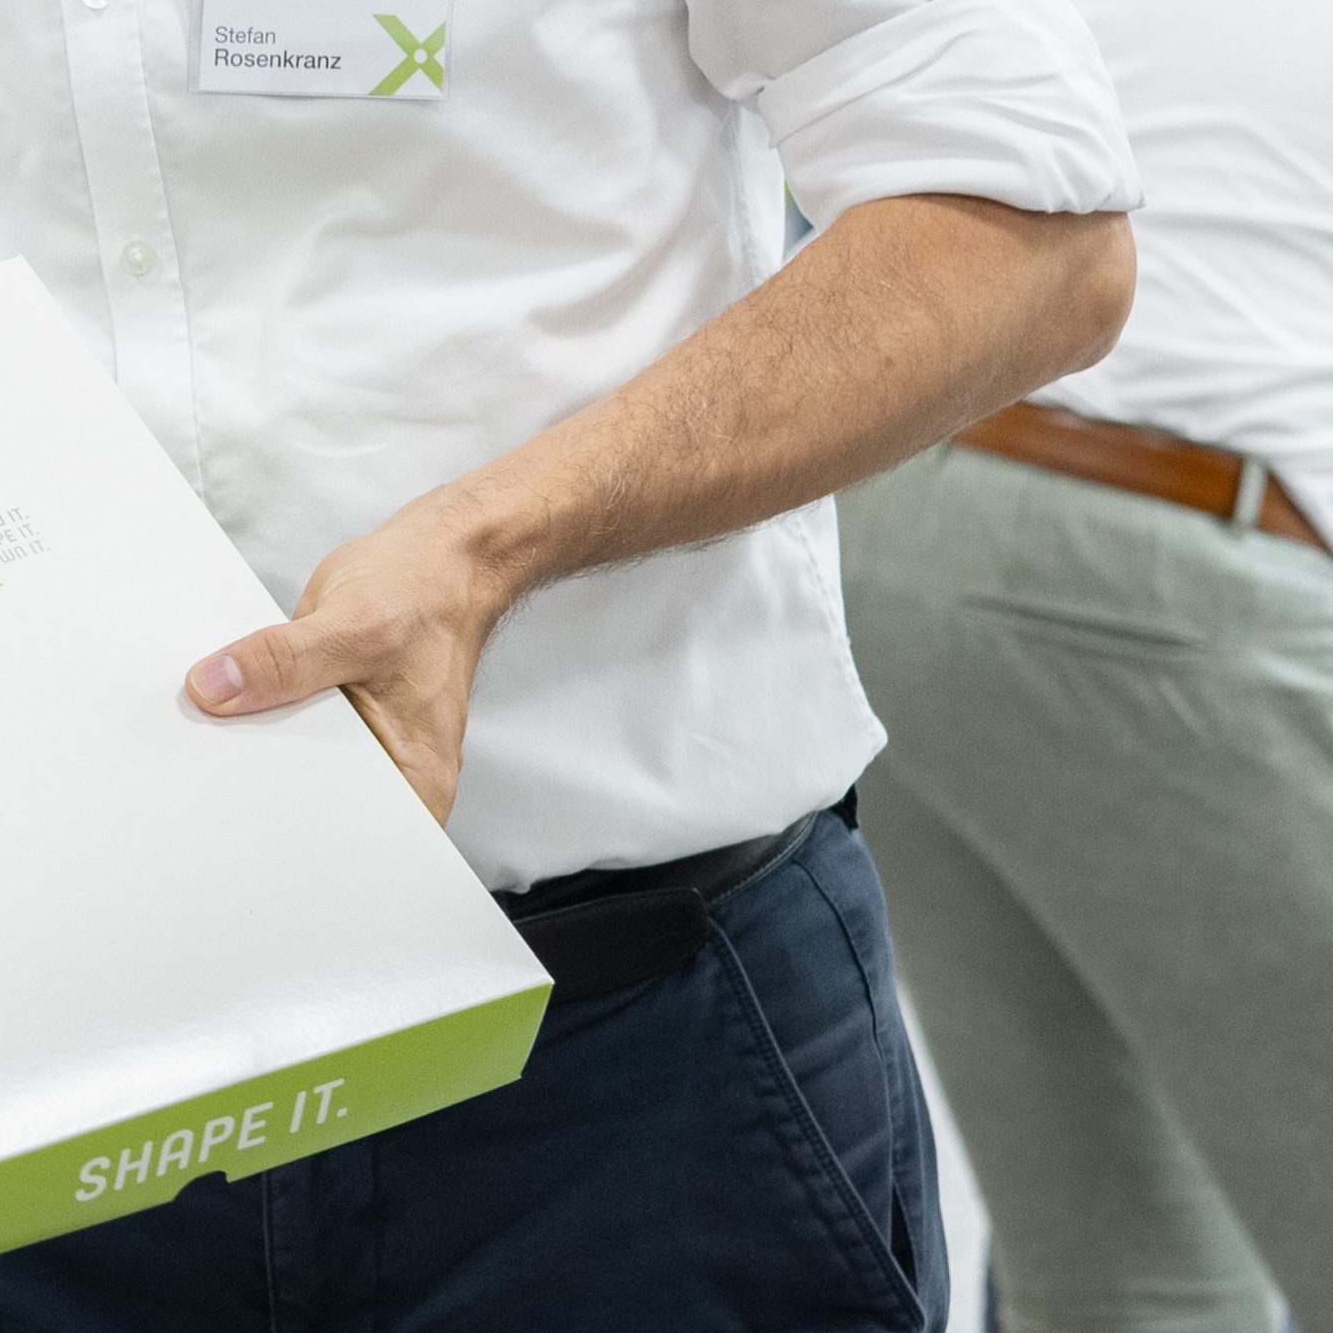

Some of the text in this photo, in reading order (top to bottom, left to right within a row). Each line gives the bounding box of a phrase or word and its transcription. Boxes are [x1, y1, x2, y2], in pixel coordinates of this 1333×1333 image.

[214, 25, 277, 45] Stefan
[213, 47, 342, 70] Rosenkranz
[6, 507, 30, 523] IT.
[17, 522, 41, 539] IT.
[28, 539, 52, 555] IT.
[74, 1077, 349, 1203] SHAPE IT.
